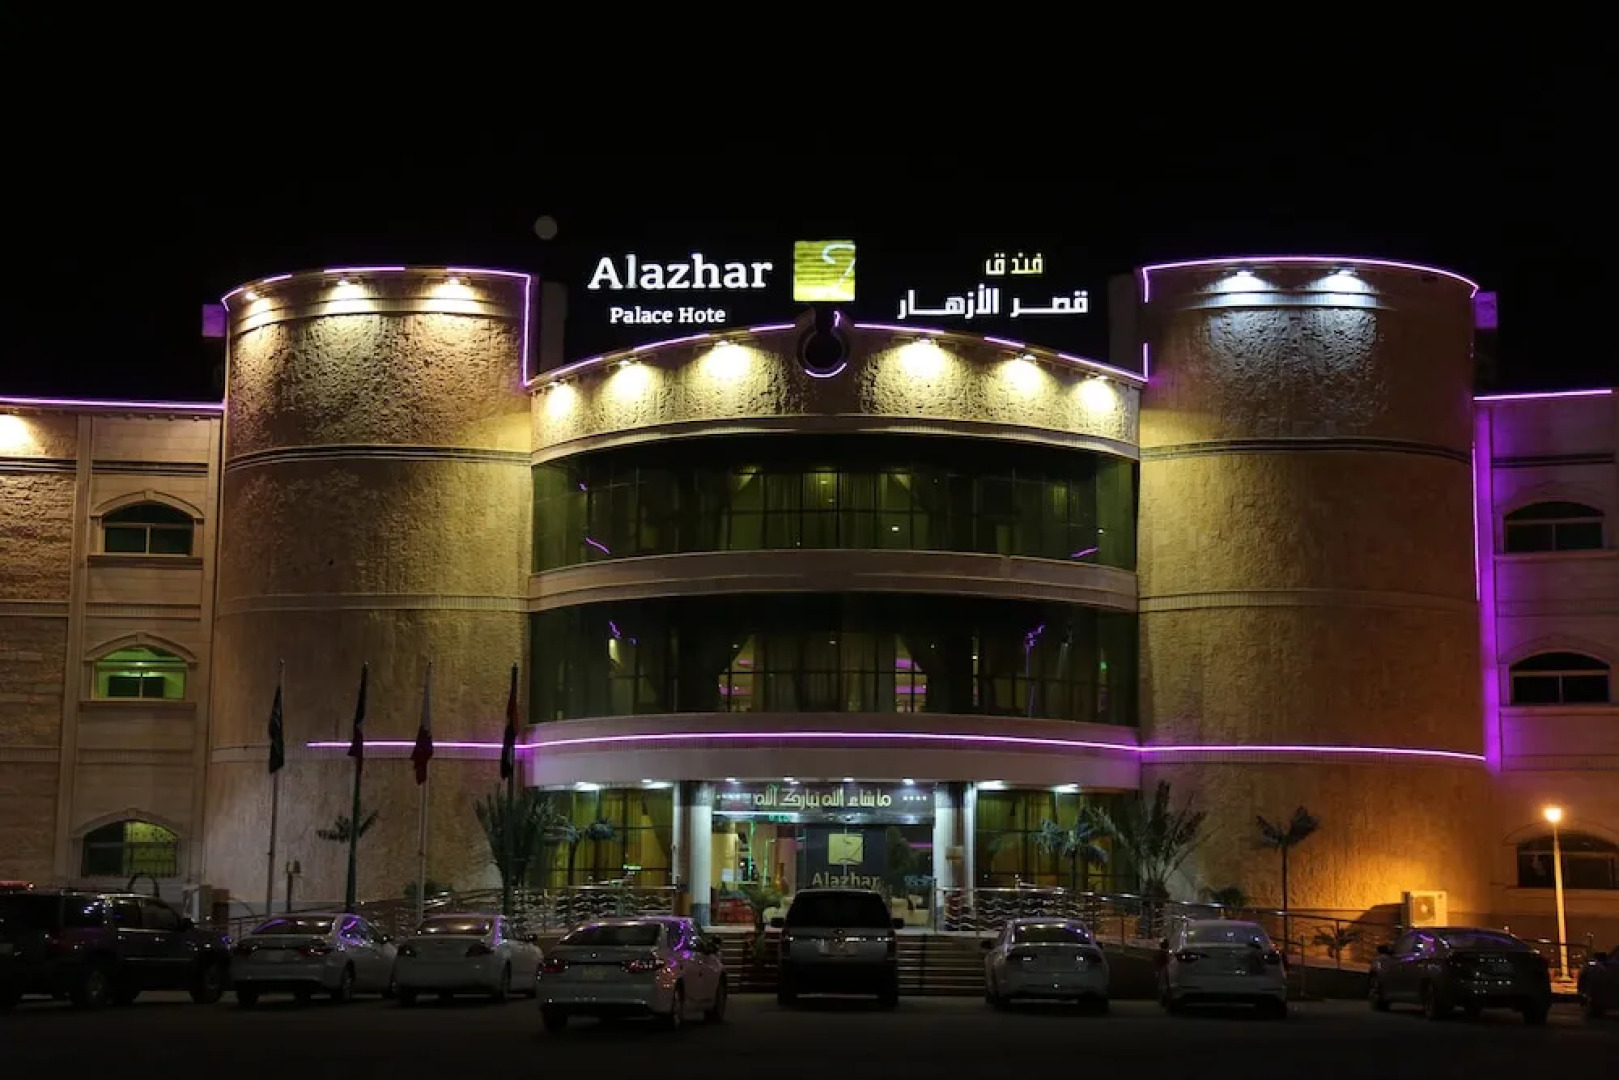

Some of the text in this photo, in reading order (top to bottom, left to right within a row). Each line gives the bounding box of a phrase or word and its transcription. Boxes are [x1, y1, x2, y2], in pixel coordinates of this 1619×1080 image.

[587, 253, 773, 290] Alazhar
[897, 283, 1089, 320] قصر الأزهار
[609, 305, 726, 324] Palace Hote
[822, 786, 845, 807] الله
[812, 871, 880, 888] Alazhar
